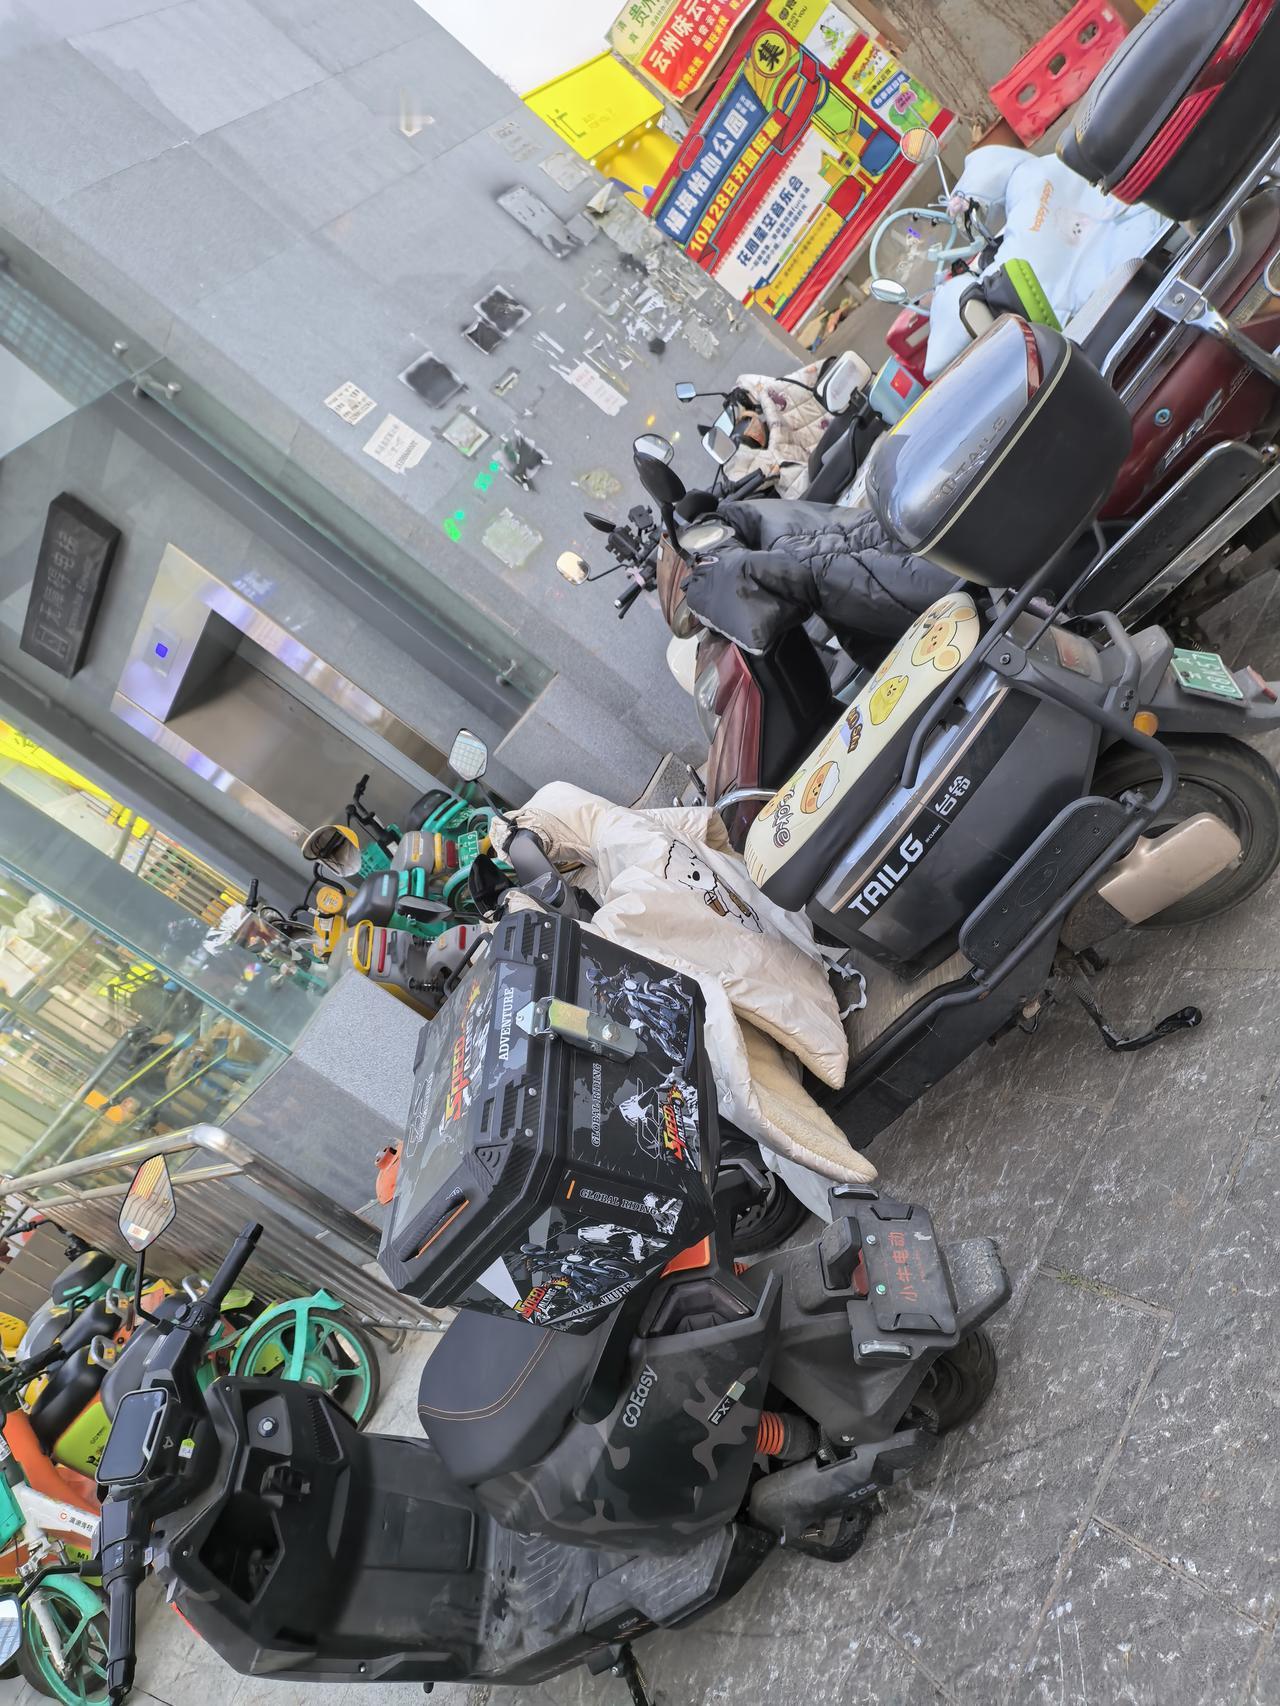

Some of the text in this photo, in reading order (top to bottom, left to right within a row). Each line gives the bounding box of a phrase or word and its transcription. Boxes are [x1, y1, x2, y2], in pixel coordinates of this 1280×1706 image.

[758, 39, 785, 71] 集
[664, 108, 748, 234] 福海怡心公园
[690, 117, 783, 253] 10月28日开园钜惠
[736, 175, 804, 267] 花园星空音乐会
[39, 530, 79, 626] 无障碍电梯
[934, 775, 972, 816] 台铃
[848, 832, 924, 916] TAILG
[498, 986, 514, 1061] ADVENTURE
[445, 1035, 467, 1121] SPEED
[591, 1062, 602, 1148] GLOBAL RIDING
[662, 1104, 687, 1160] SPEED
[579, 1187, 658, 1216] GLOBAL RIDING
[512, 1287, 544, 1319] SPEED
[570, 1283, 633, 1317] ADVNTURE
[886, 1231, 920, 1303] 小牛电动
[622, 1364, 658, 1429] GOEasy
[847, 1482, 878, 1501] TCS
